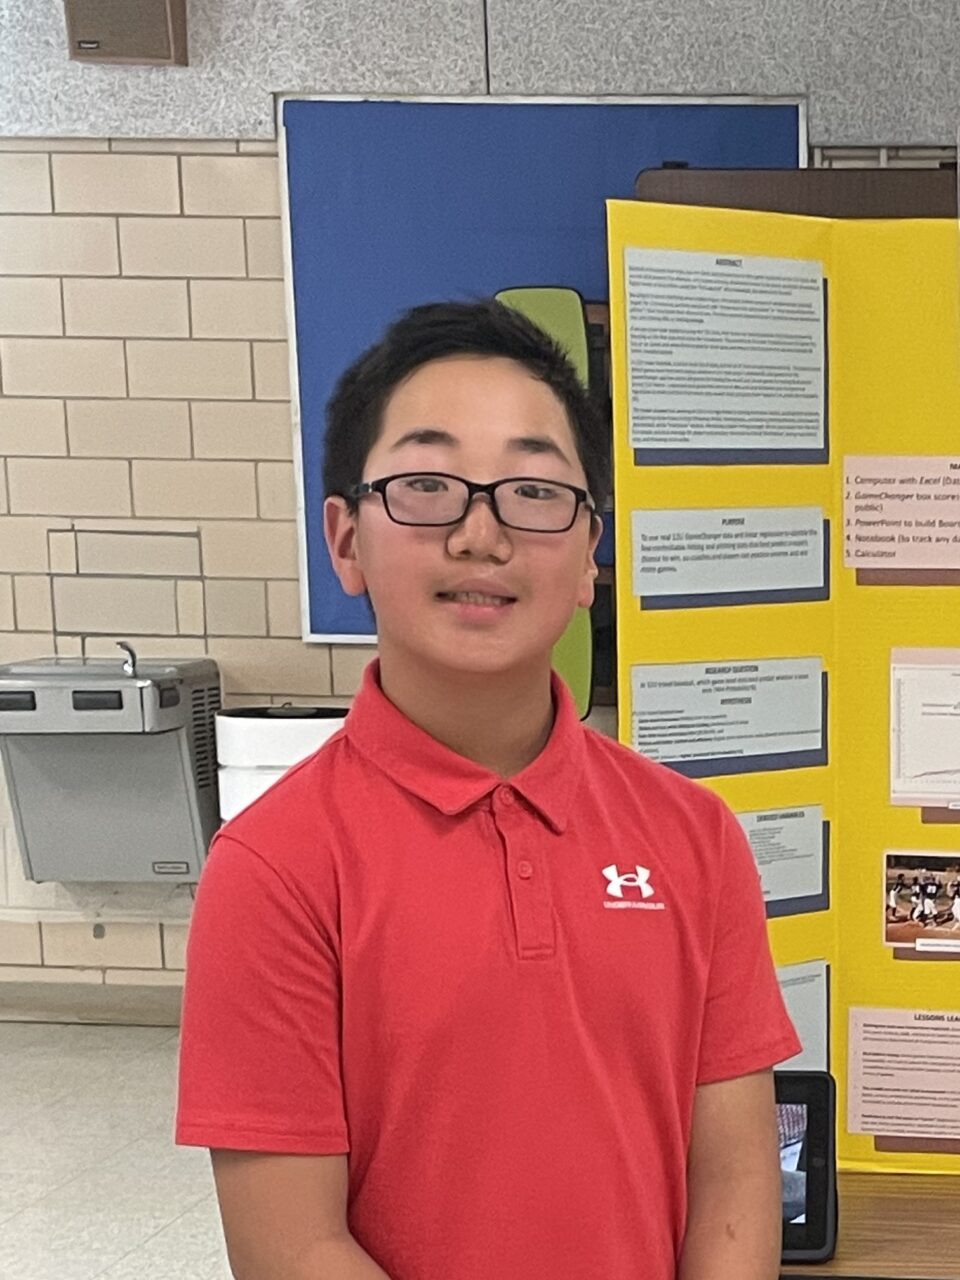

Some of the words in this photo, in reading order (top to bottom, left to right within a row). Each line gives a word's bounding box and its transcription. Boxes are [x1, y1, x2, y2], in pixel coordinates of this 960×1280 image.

[855, 476, 896, 486] Computer
[899, 476, 917, 485] with
[919, 476, 941, 485] Excel
[916, 492, 931, 500] box
[934, 493, 960, 501] scores
[855, 504, 883, 513] public)
[904, 519, 913, 527] to
[915, 519, 936, 527] build
[855, 534, 896, 542] Notebook
[912, 535, 932, 543] track
[935, 536, 950, 544] any
[855, 549, 896, 557] Calculator
